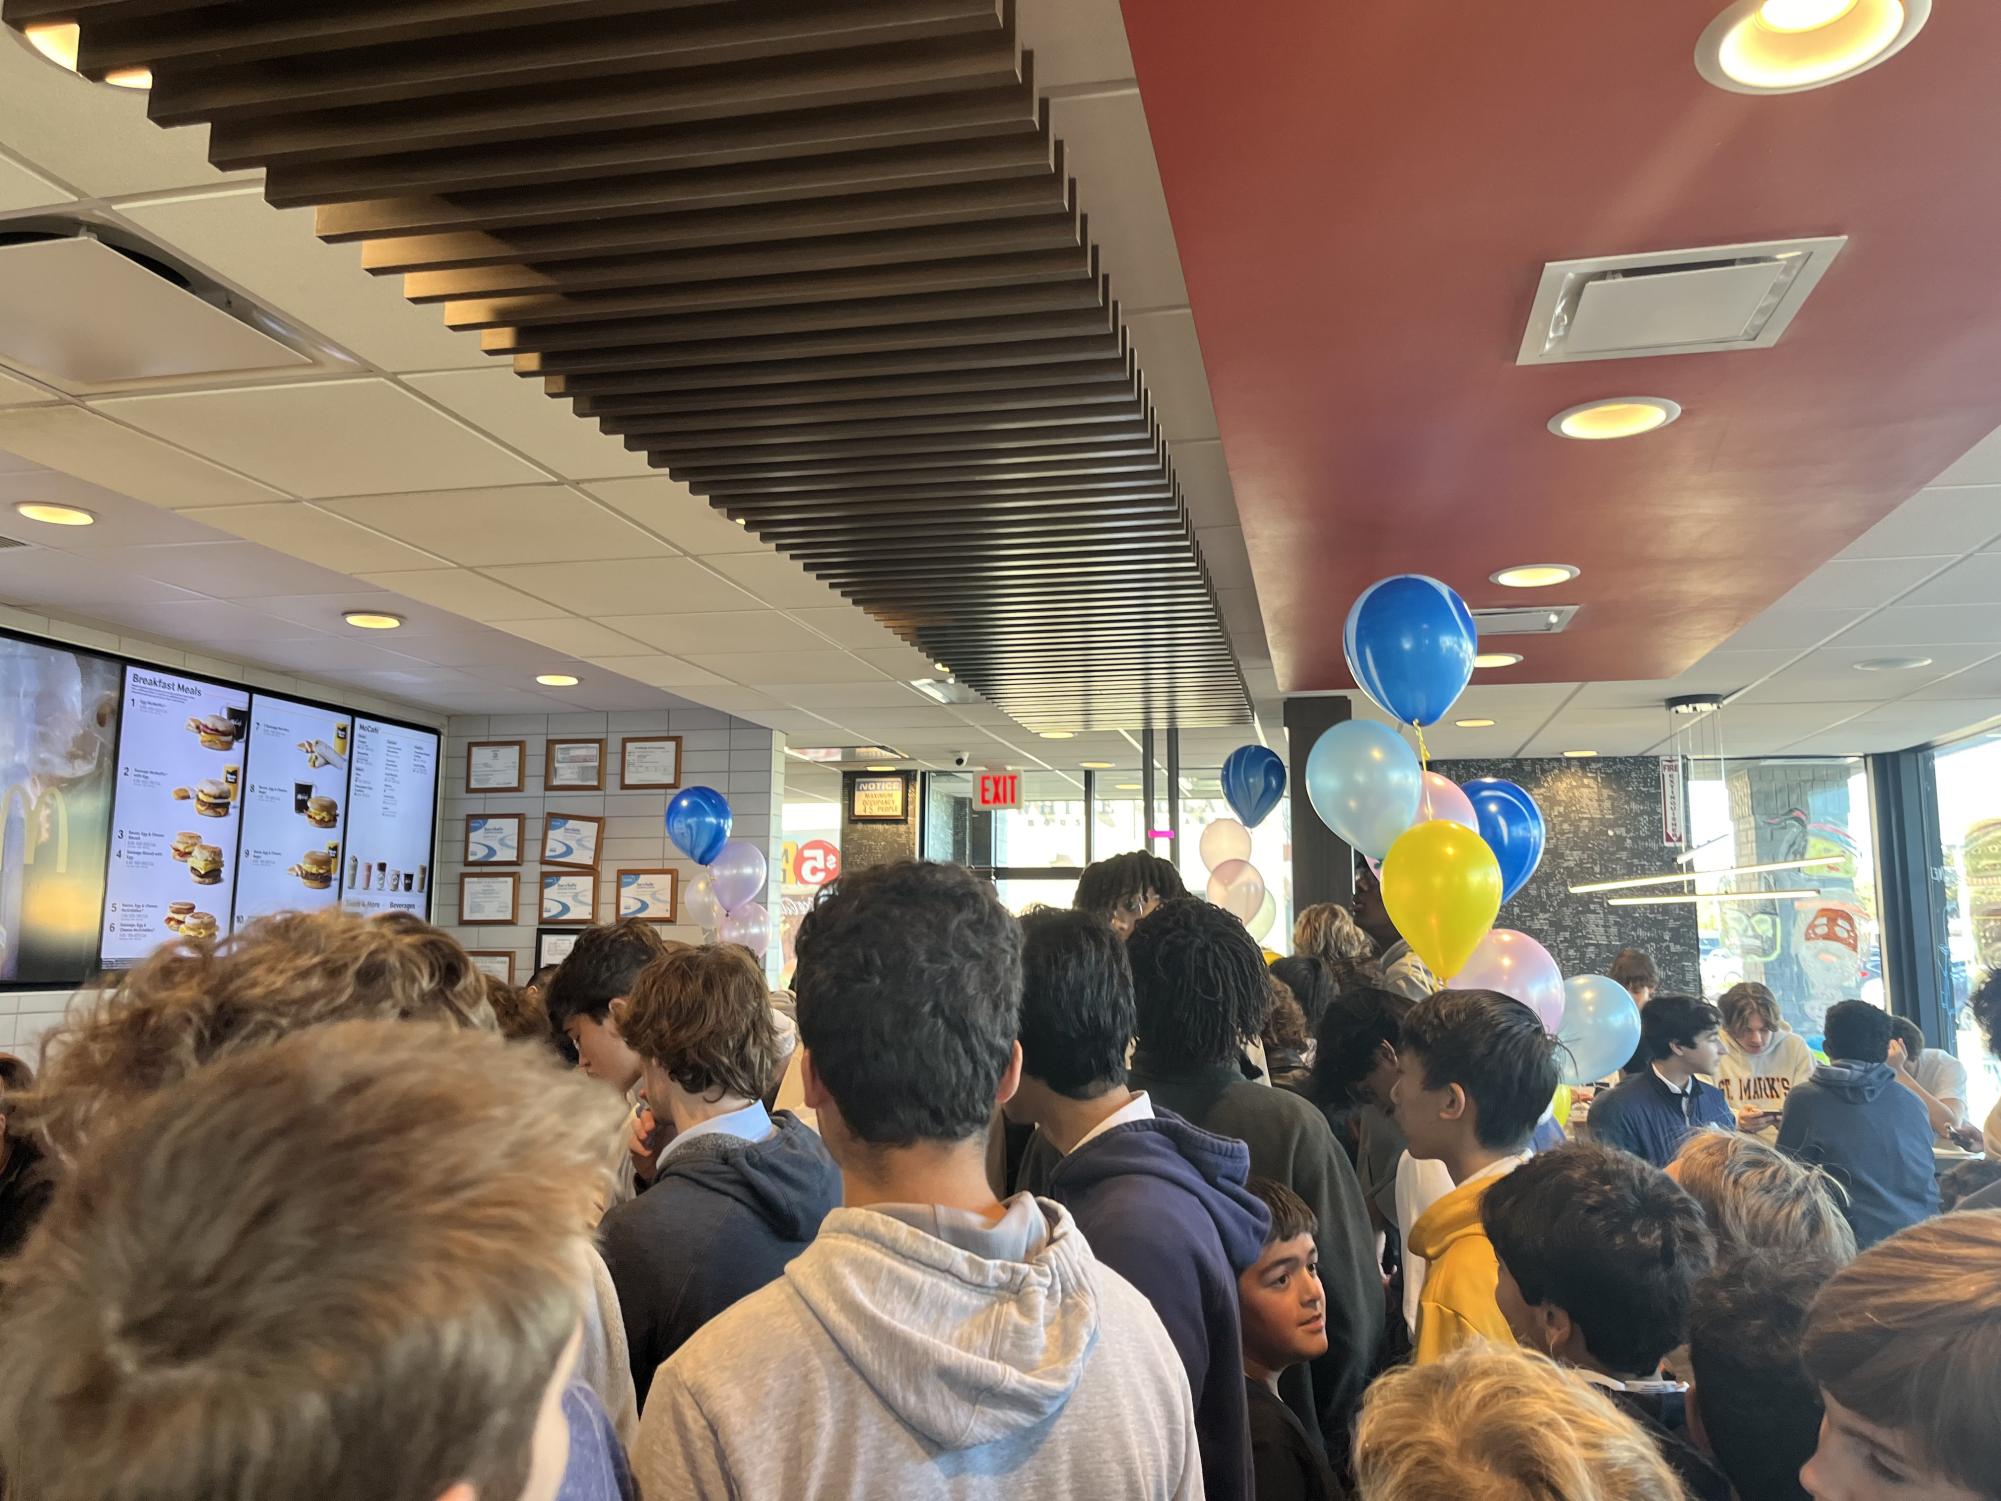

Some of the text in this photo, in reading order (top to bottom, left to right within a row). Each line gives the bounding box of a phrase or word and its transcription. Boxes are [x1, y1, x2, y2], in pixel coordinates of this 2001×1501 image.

[132, 673, 175, 691] Breakfast
[177, 683, 202, 697] Meals
[131, 698, 135, 707] 1
[123, 767, 129, 776] 2
[1663, 764, 1678, 772] FIRE
[860, 782, 900, 790] NOTICE
[980, 775, 1017, 805] EXIT
[117, 830, 124, 839] 3
[116, 850, 122, 858] 4
[244, 849, 250, 858] 9
[111, 903, 117, 912] 5
[389, 902, 415, 911] Beverages
[109, 922, 115, 932] 6
[1740, 1077, 1791, 1100] MARK'S
